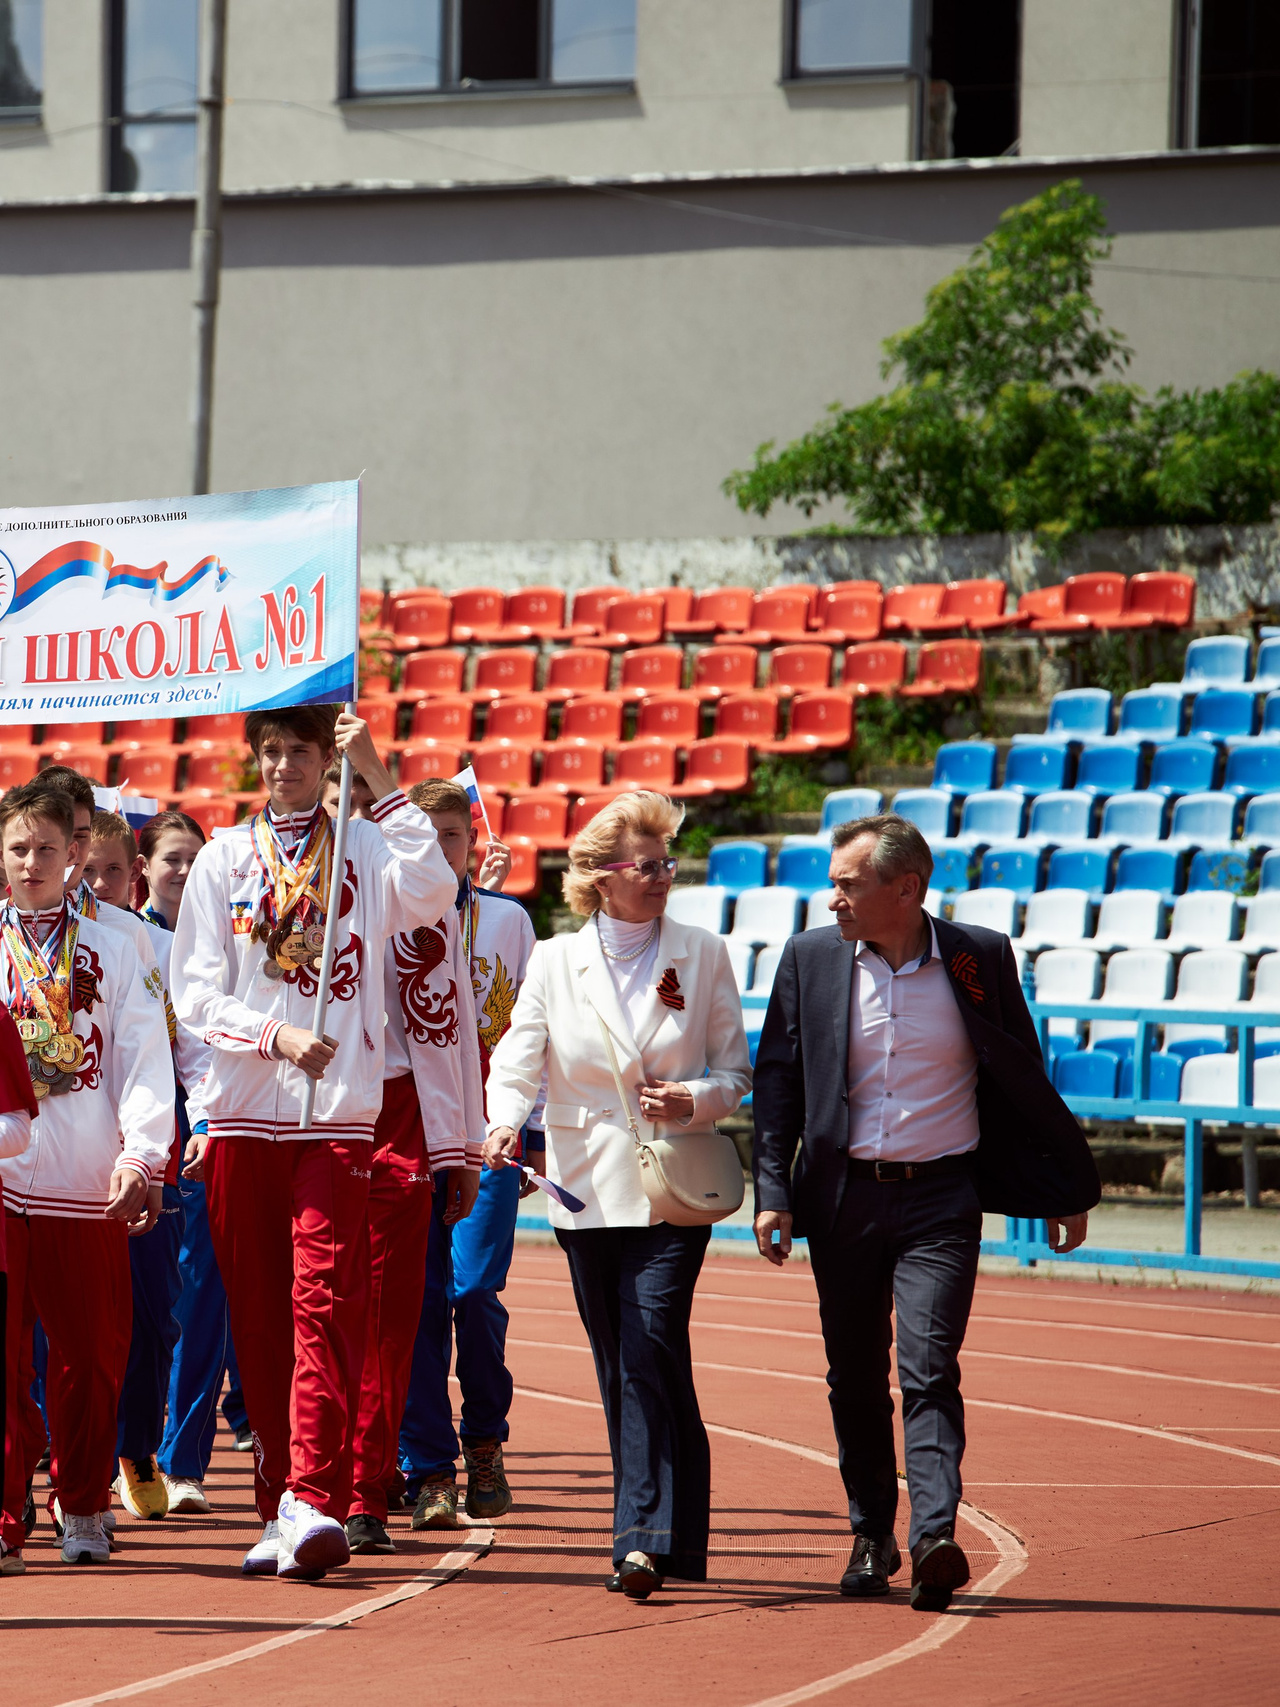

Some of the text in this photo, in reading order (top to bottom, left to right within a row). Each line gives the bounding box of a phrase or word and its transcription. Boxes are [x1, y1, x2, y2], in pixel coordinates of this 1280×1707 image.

[5, 517, 114, 533] ДОПОЛНИТЕЛЬНОГО
[116, 511, 188, 526] ОБРАЗОВАНИЯ
[22, 603, 243, 685] ШКОЛА
[255, 572, 328, 672] №1
[40, 691, 160, 710] начинается
[165, 681, 222, 704] здесь!
